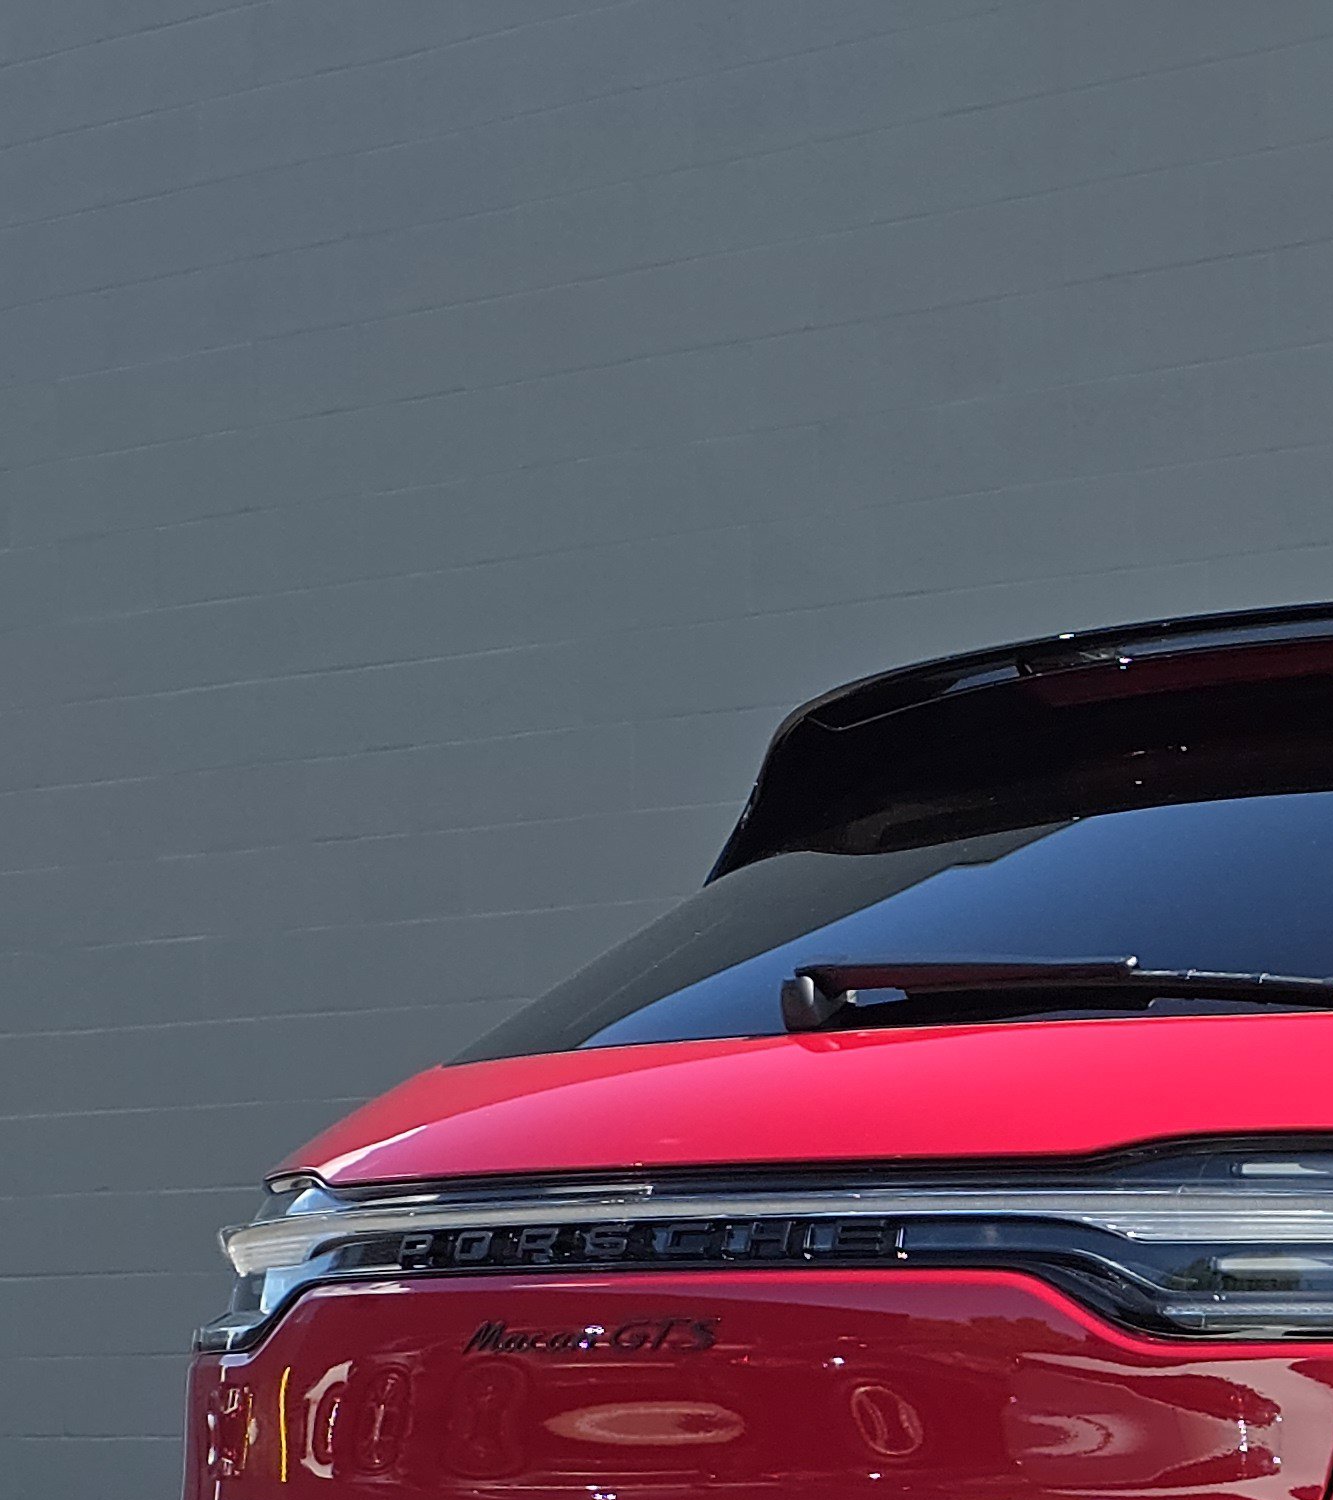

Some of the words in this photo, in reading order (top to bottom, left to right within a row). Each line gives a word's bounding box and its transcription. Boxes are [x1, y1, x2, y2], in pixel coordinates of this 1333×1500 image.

[399, 1219, 887, 1264] PORSCHE
[463, 1320, 604, 1354] Macan
[609, 1316, 721, 1352] GTS
